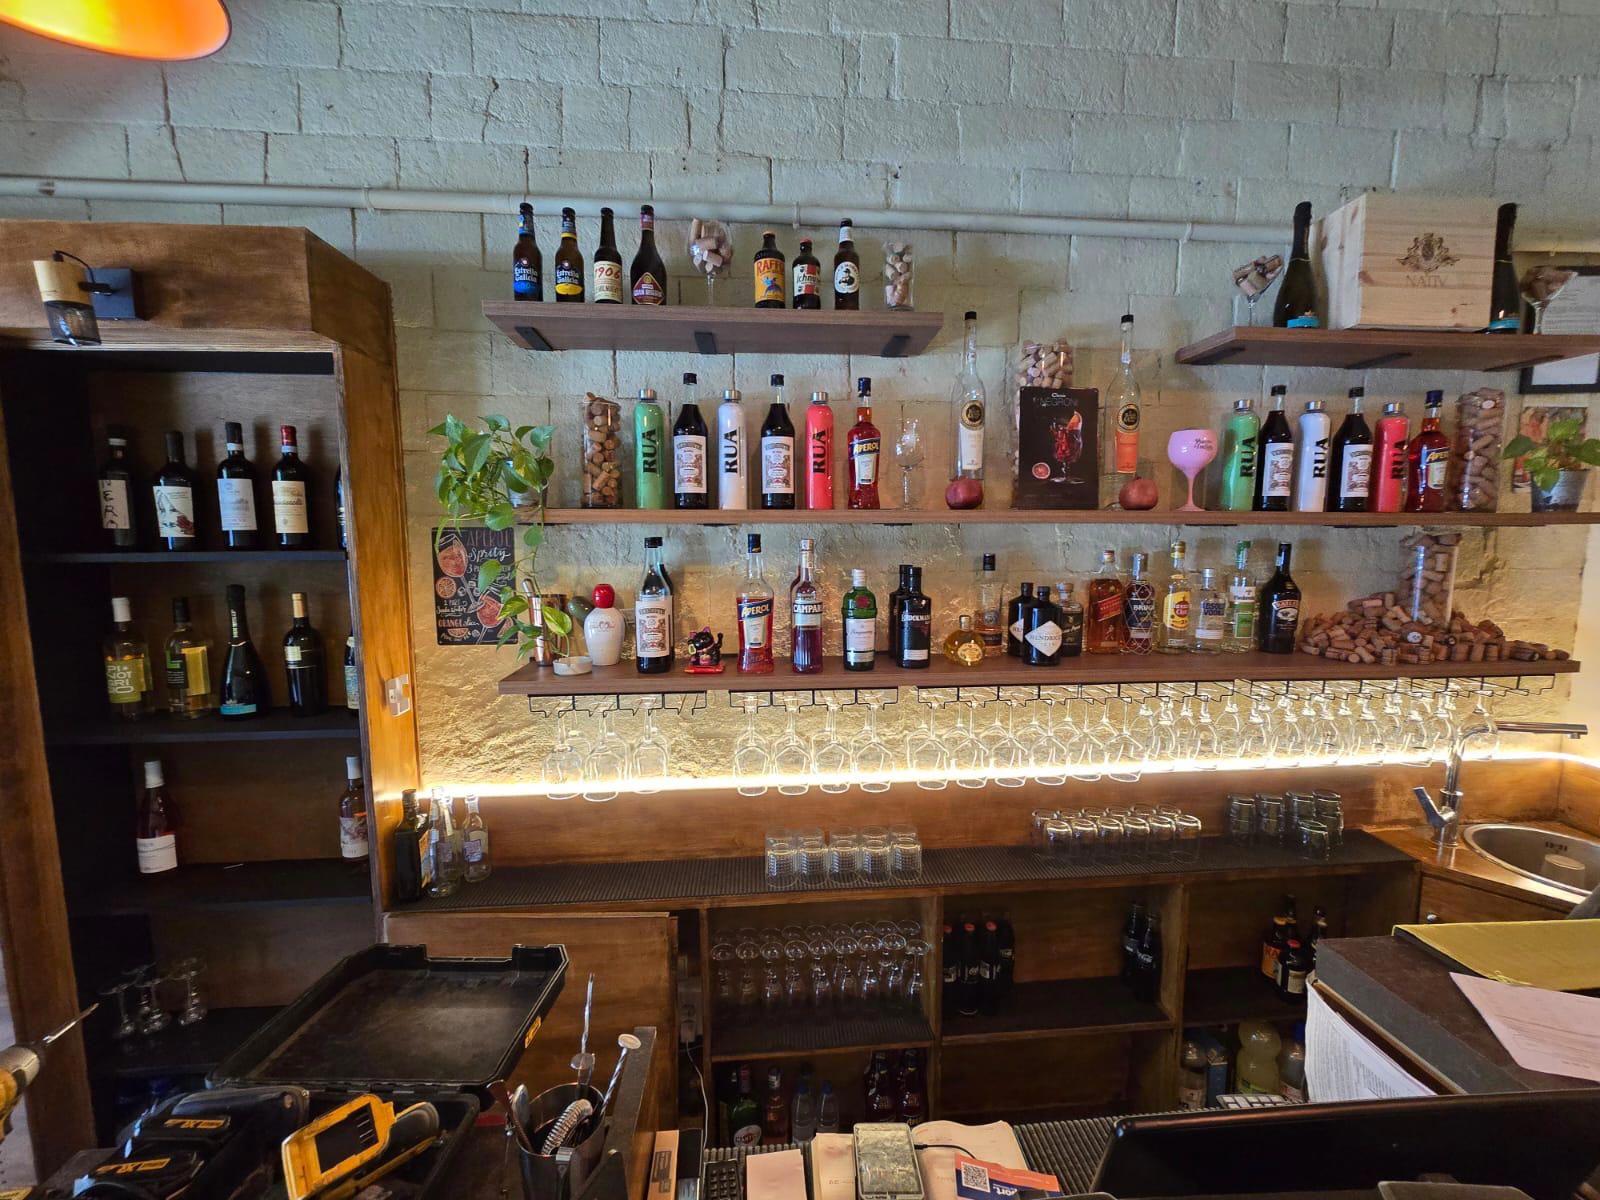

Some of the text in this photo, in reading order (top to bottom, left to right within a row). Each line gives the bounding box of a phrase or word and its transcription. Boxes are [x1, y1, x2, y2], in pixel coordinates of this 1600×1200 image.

[514, 266, 538, 276] Estrella
[642, 429, 657, 473] RUA
[724, 427, 738, 474] RUA
[812, 430, 826, 474] RUA
[853, 440, 880, 455] APEROL
[1240, 436, 1256, 478] RUA
[1312, 437, 1329, 479] RUA
[741, 603, 770, 618] APEROL
[793, 604, 823, 614] CAMPA
